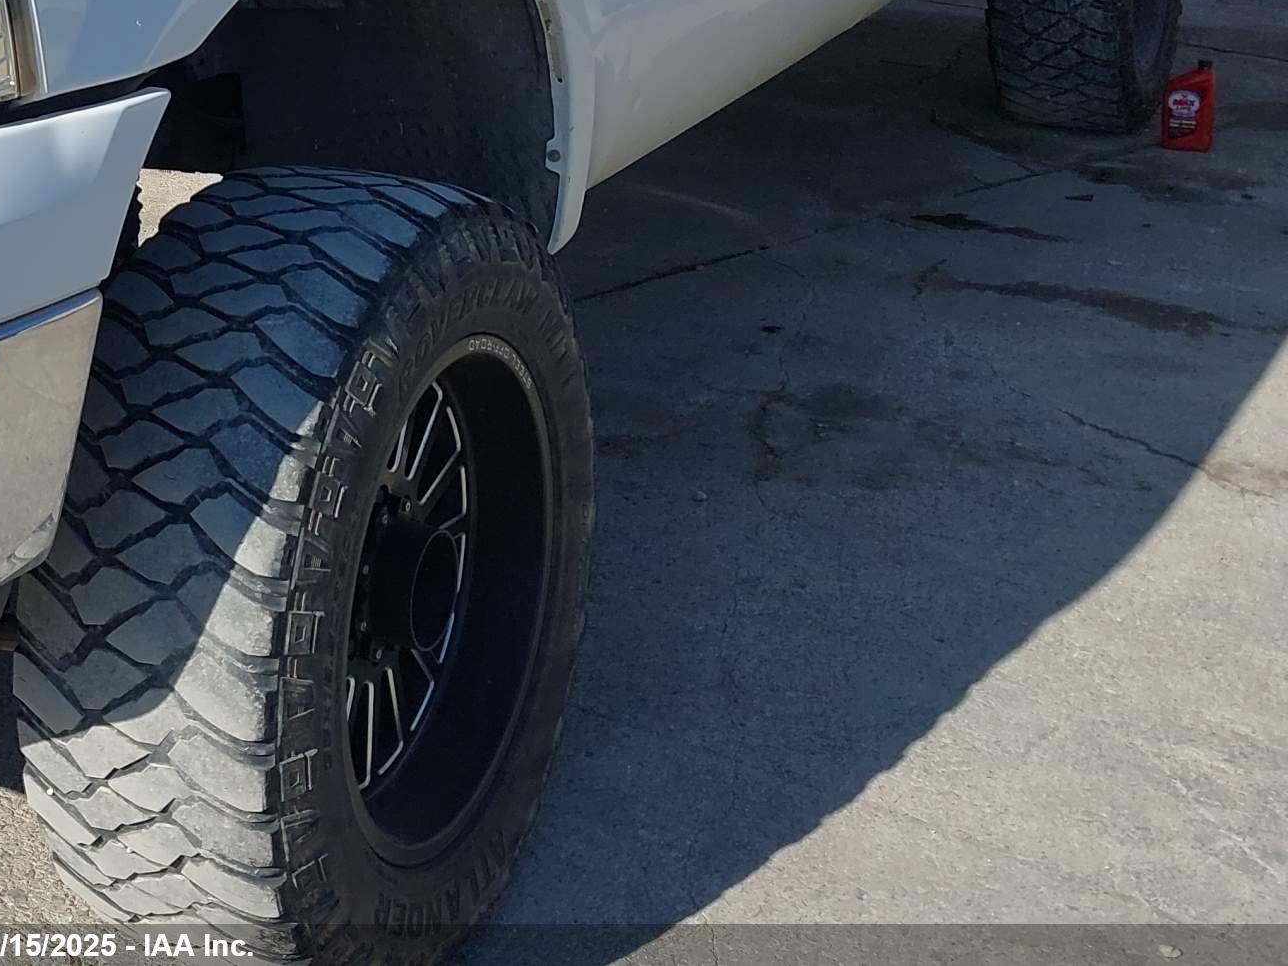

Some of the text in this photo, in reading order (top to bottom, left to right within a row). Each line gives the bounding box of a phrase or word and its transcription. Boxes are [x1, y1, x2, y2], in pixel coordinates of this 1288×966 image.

[468, 338, 533, 389] STEEL OFF-ROAD
[373, 830, 506, 937] ATLANDER
